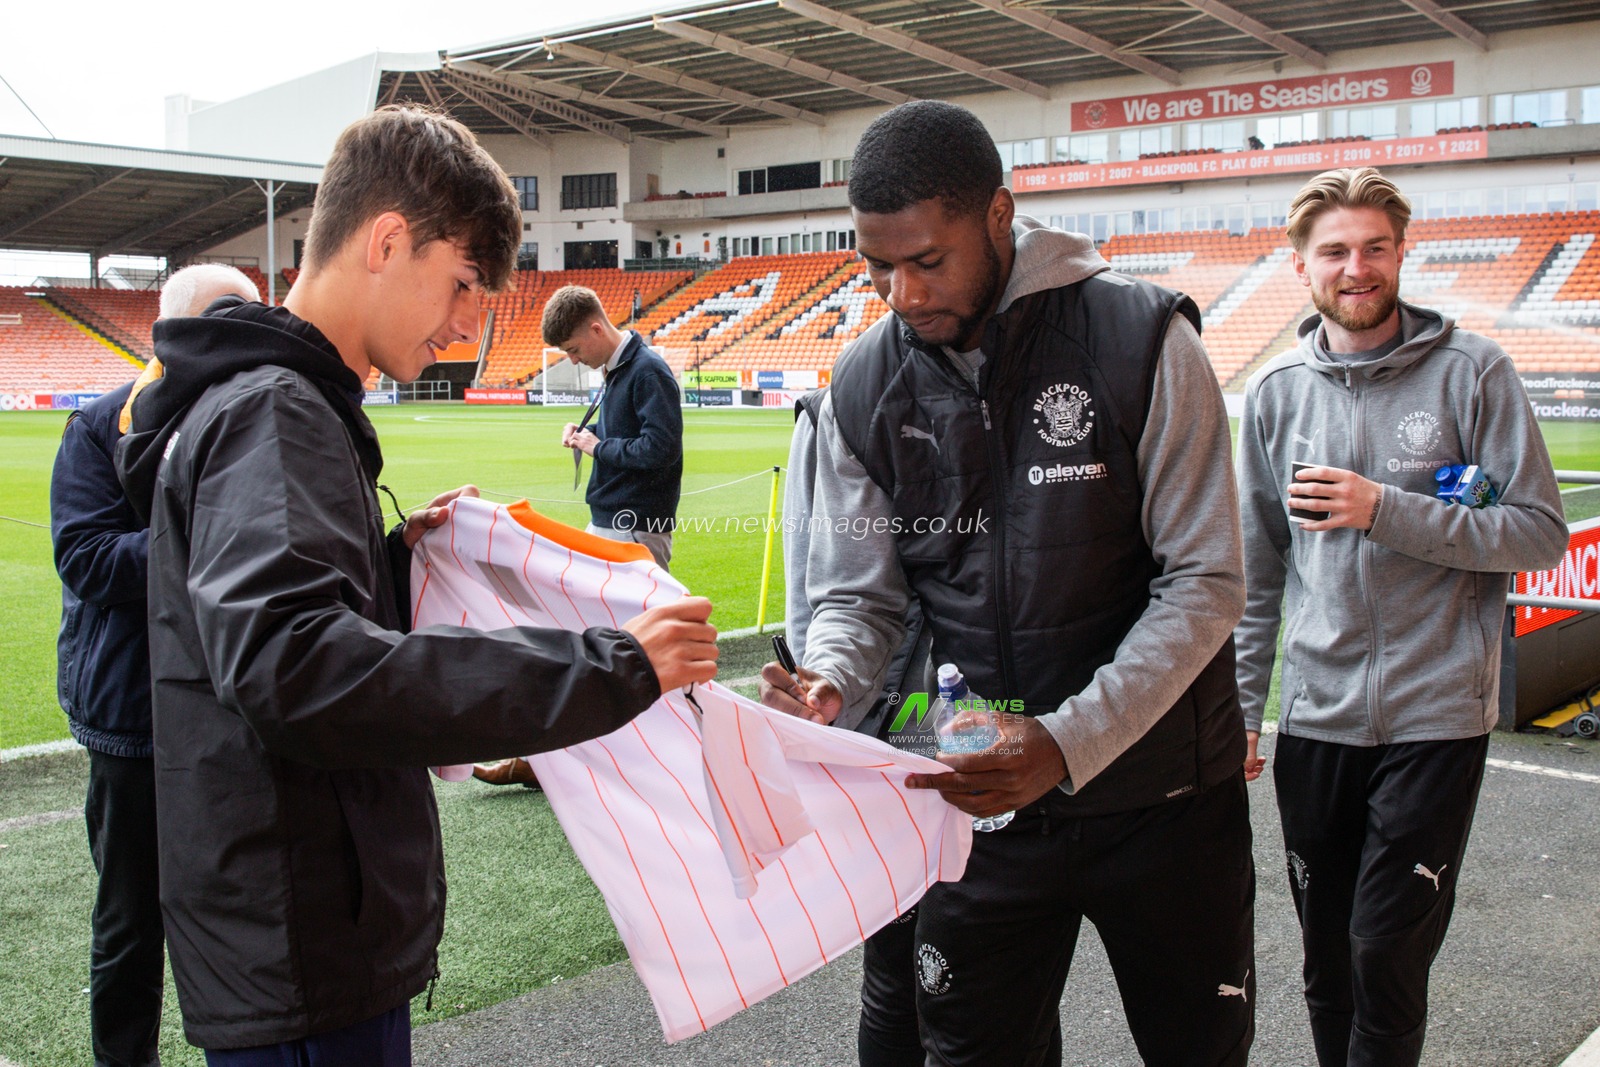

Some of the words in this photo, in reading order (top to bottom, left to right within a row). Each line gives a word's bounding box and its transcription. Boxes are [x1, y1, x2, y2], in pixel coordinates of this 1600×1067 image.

[1123, 99, 1160, 122] We
[1165, 98, 1203, 119] are
[1208, 90, 1254, 114] The
[1259, 77, 1388, 110] Seasiders
[1026, 174, 1046, 186] 1992
[1067, 171, 1090, 182] 2001
[1109, 167, 1132, 180] 2007
[1142, 162, 1200, 176] BLACKPOOL
[1222, 158, 1248, 170] PLAY
[1250, 156, 1270, 168] OFF
[1273, 152, 1322, 167] WINNERS
[1344, 148, 1371, 162] 2010
[1396, 144, 1424, 156] 2017
[1451, 140, 1480, 153] 2021
[1033, 384, 1092, 412] BLACKPOOL
[1398, 411, 1439, 430] BLACKPOOL
[1038, 429, 1076, 447] FOOTBALL
[1077, 422, 1093, 440] CLUB
[1400, 442, 1426, 456] FOOTBALL
[1045, 463, 1106, 478] eleven
[1402, 459, 1450, 469] eleven
